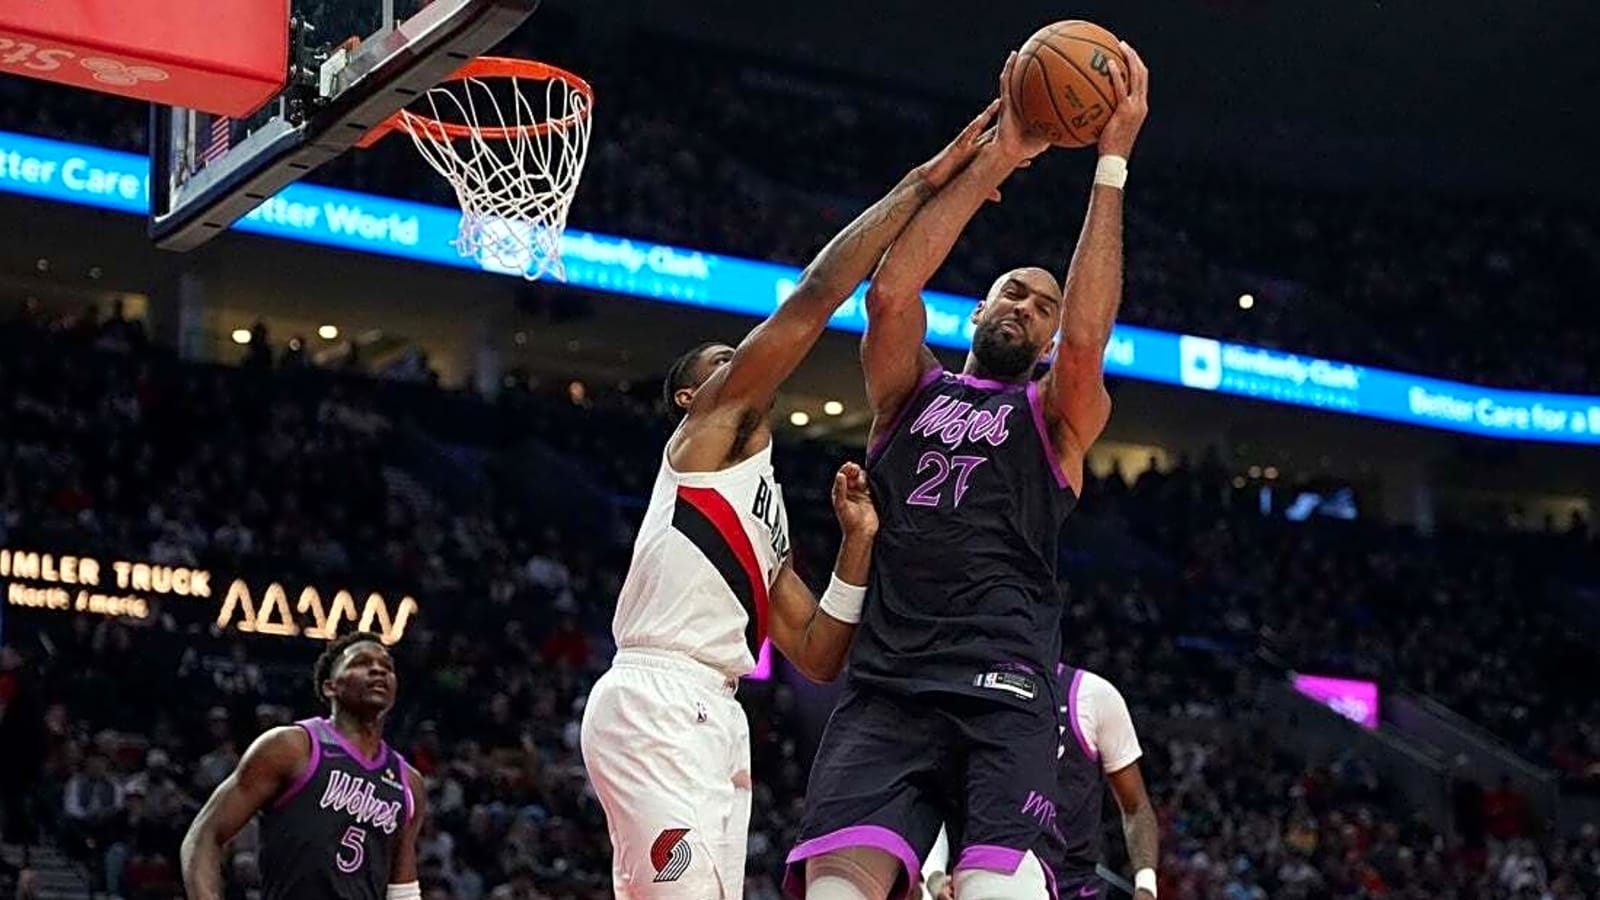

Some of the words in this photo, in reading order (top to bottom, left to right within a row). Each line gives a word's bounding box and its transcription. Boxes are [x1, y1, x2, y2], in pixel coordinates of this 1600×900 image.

[61, 157, 139, 199] Care
[323, 201, 418, 245] World
[906, 450, 989, 508] 27
[113, 561, 211, 598] TRUCK
[320, 770, 401, 835] Wolves
[336, 825, 366, 873] 5
